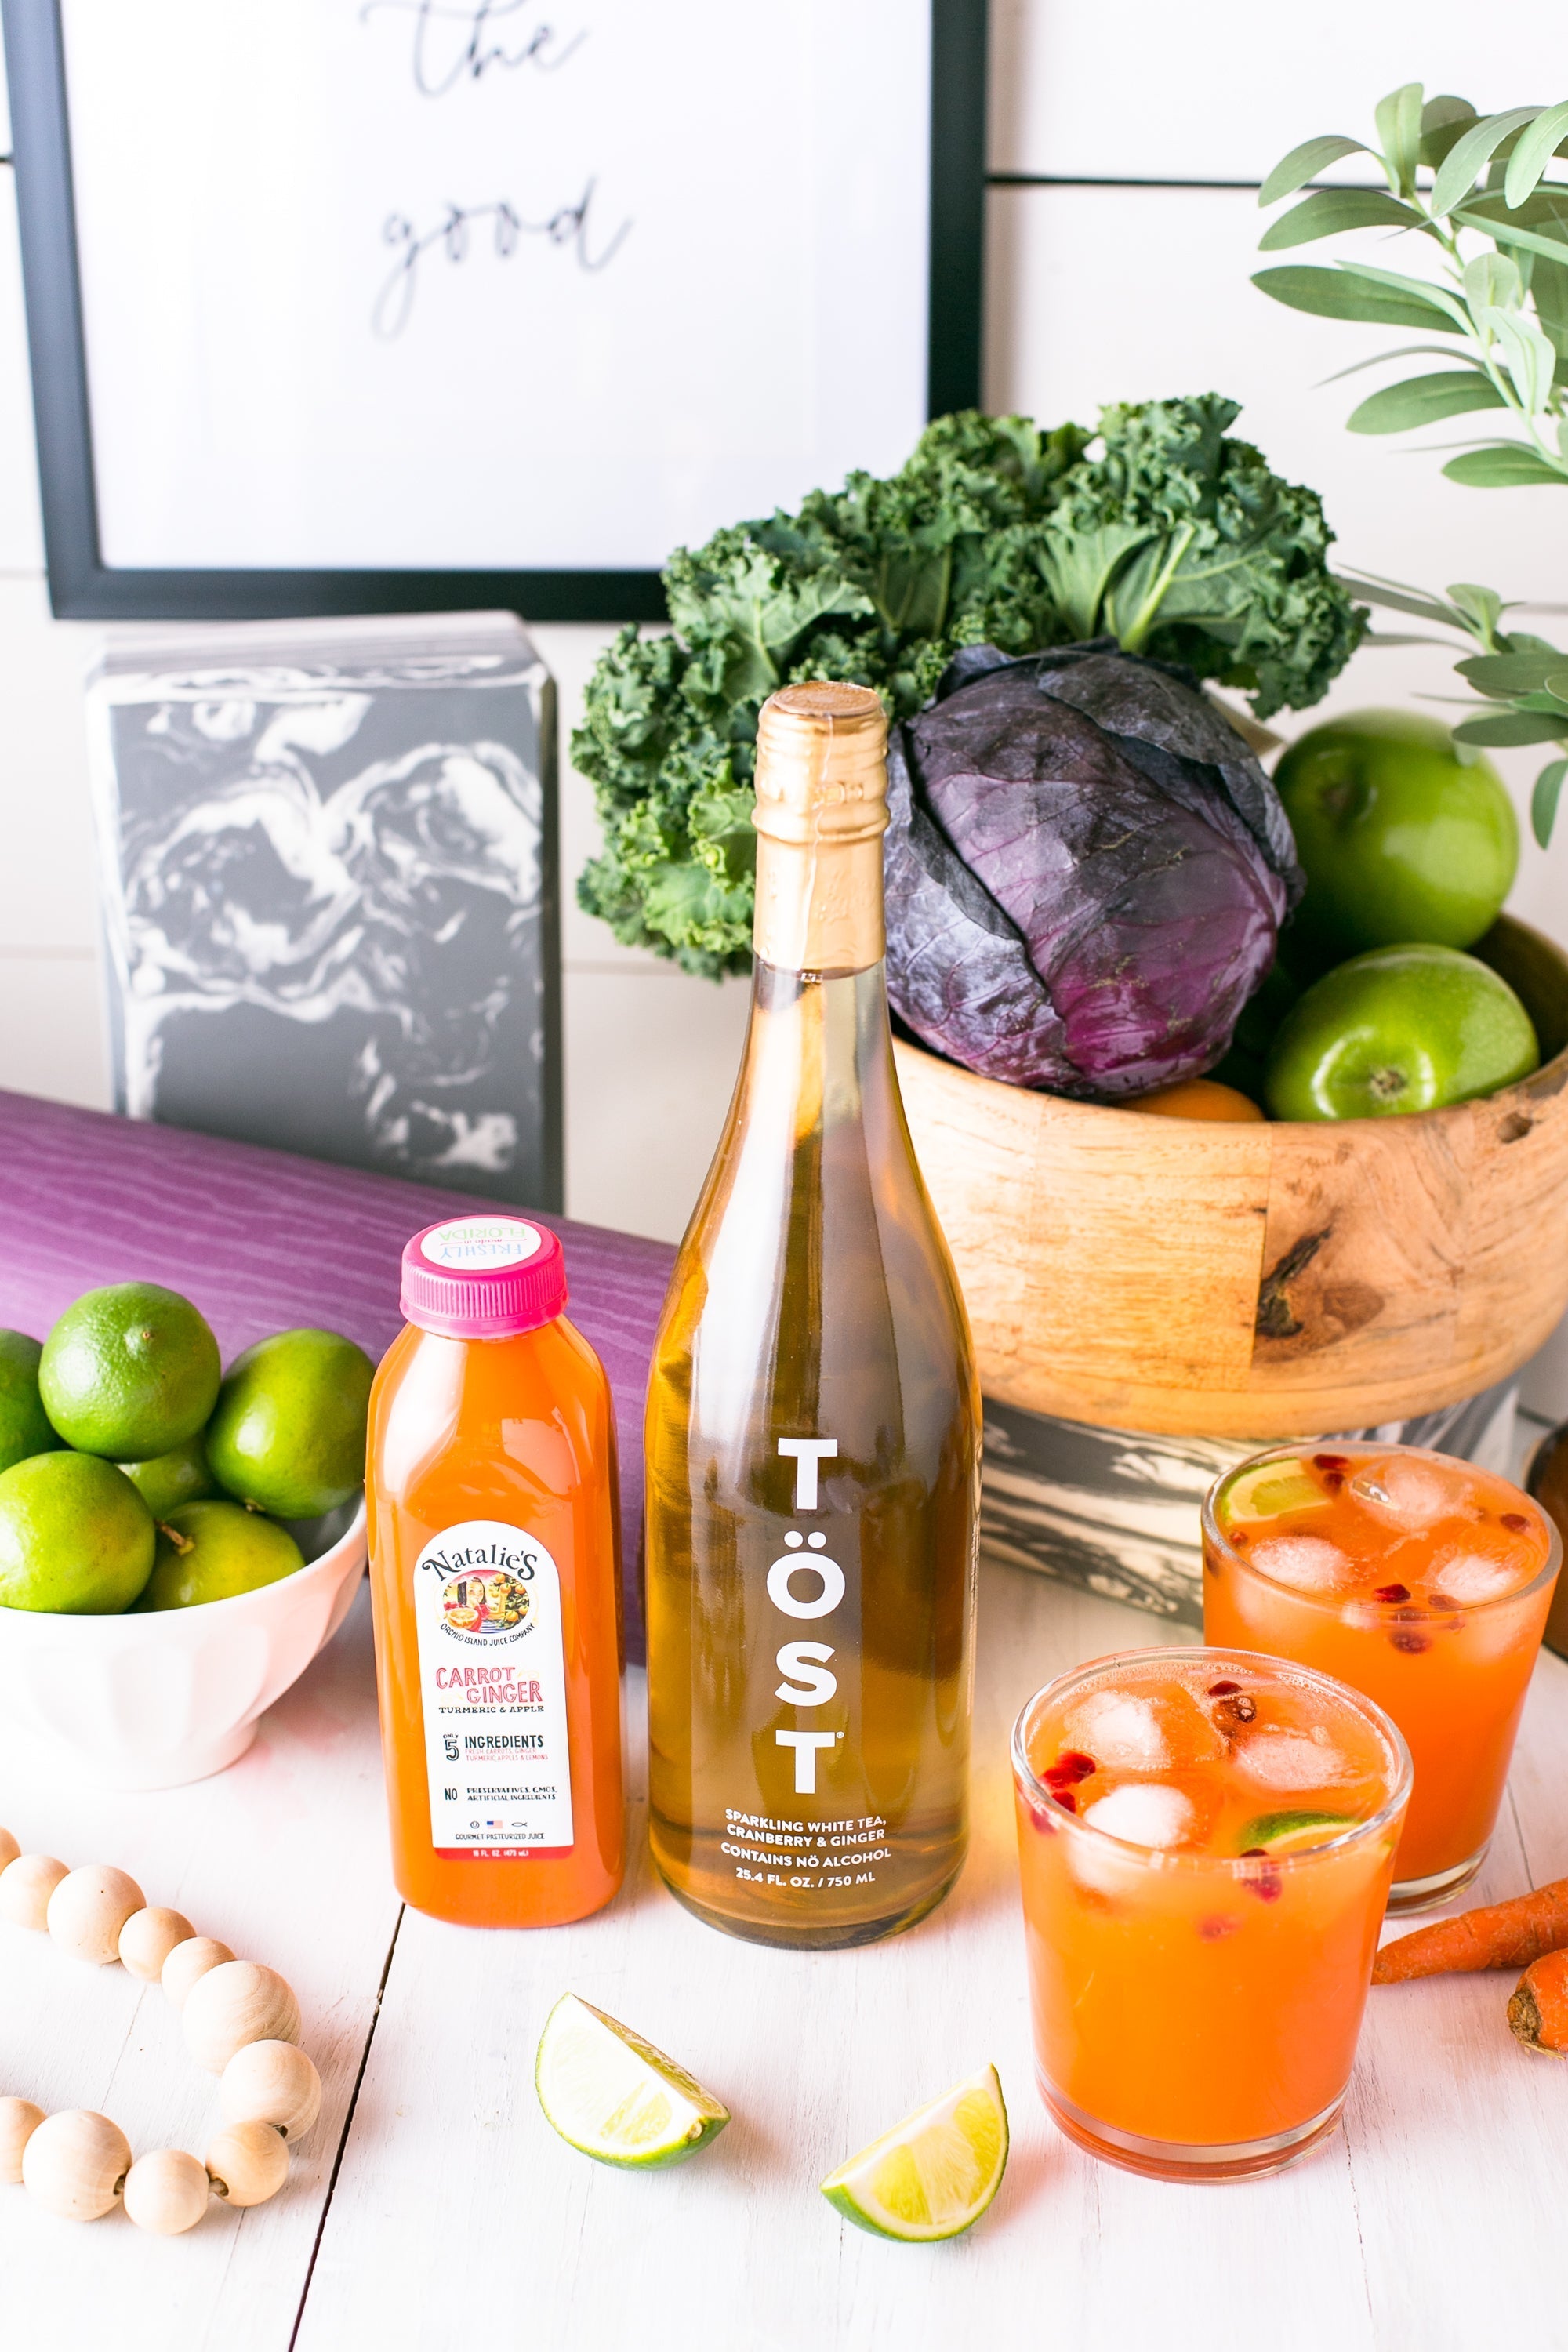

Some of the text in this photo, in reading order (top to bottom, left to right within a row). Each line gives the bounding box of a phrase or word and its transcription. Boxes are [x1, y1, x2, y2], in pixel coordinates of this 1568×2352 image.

[371, 173, 634, 343] good
[439, 1227, 525, 1241] FLORIDA
[439, 1243, 521, 1260] FRESHLY
[440, 1622, 535, 1646] ORCHID ISLAND JUICE COMPANY
[436, 1667, 516, 1689] CARROT
[466, 1680, 543, 1704] GINGER
[445, 1735, 544, 1761] 5 INGREDIENTS
[445, 1788, 458, 1801] NO
[725, 1808, 887, 1833] SPARKLING WHITE TEA,
[726, 1824, 885, 1848] CRANBERRY & GINGER
[720, 1842, 891, 1867] CONTAINS NÖ ALCOHOL
[735, 1867, 876, 1888] 25.4 FL. OZ. / 750 ML
